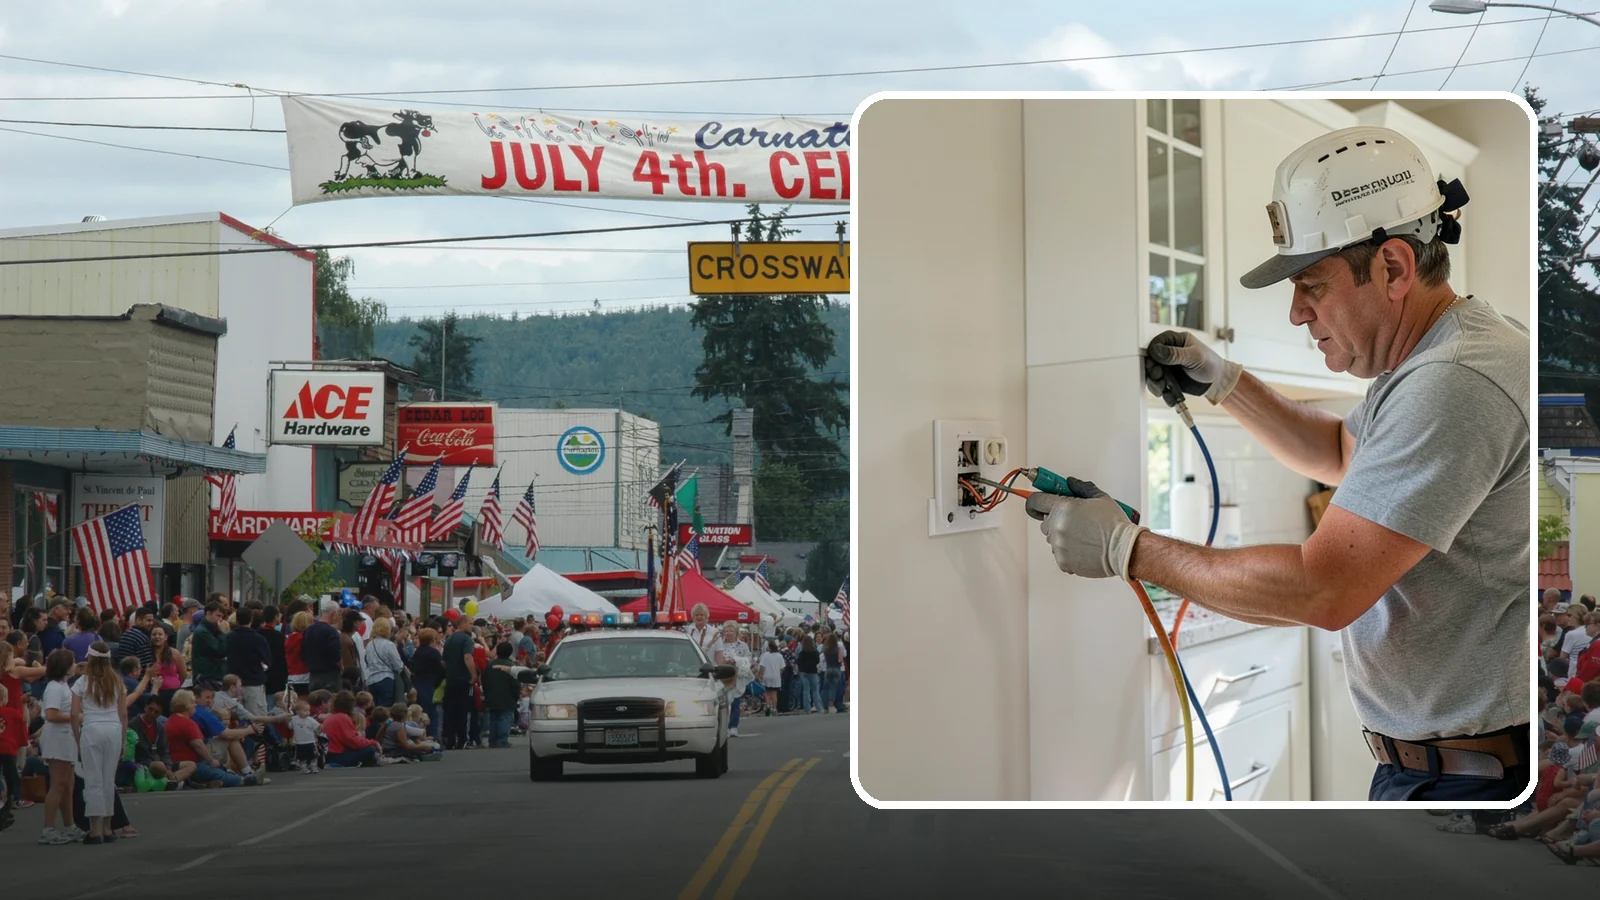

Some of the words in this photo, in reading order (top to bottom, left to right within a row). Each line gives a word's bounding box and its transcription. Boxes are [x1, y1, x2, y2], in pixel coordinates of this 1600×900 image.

[695, 122, 850, 149] Carnat
[481, 141, 605, 192] JULY
[632, 150, 746, 197] 4th.
[697, 254, 850, 280] CROSSWA
[283, 380, 373, 420] ACE
[406, 409, 452, 422] CEDAR
[283, 421, 371, 437] Hardware
[354, 467, 385, 481] Simpl
[96, 485, 124, 494] Vincent
[126, 486, 135, 494] de
[138, 486, 155, 495] Paul
[81, 503, 153, 522] THRT
[688, 527, 741, 535] CRNATION
[699, 535, 730, 543] GLASS
